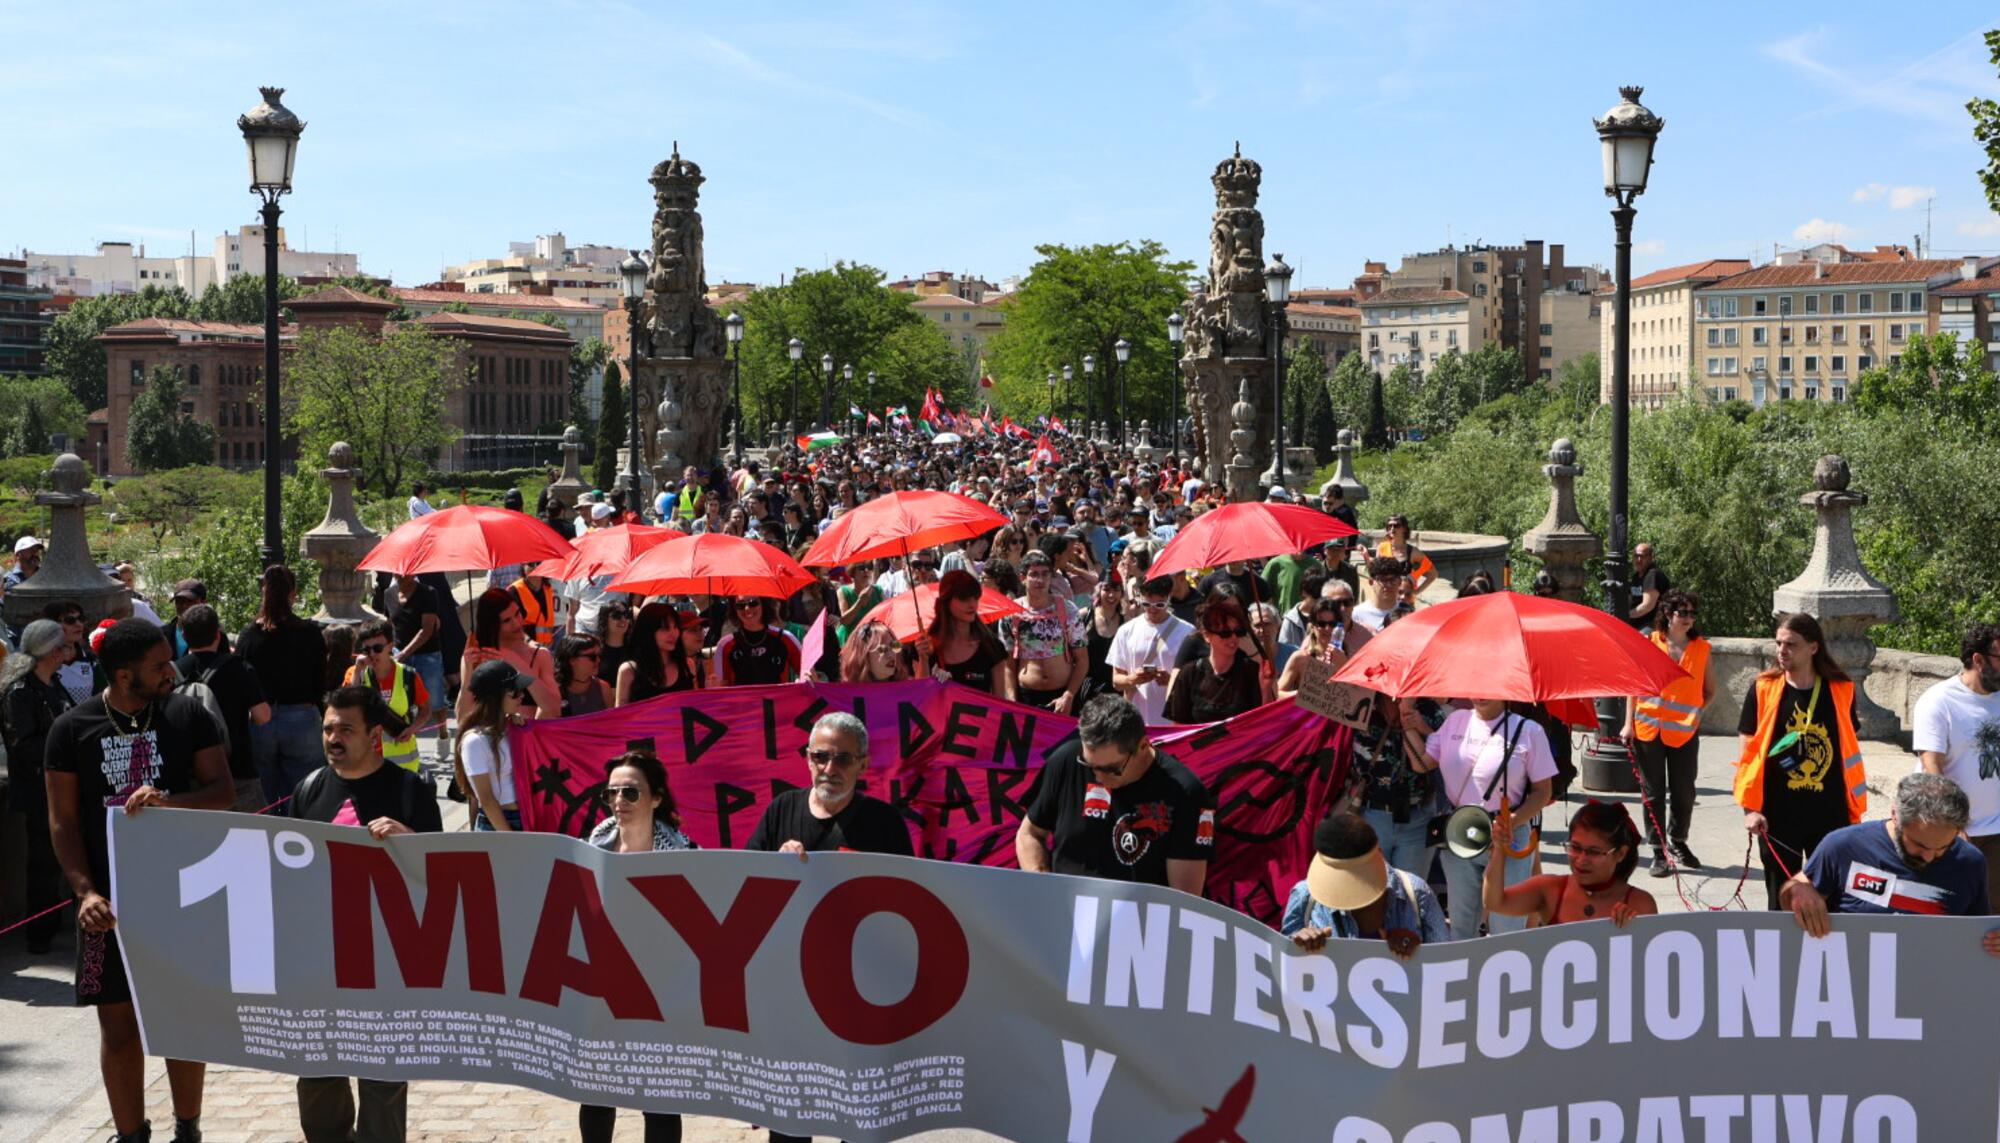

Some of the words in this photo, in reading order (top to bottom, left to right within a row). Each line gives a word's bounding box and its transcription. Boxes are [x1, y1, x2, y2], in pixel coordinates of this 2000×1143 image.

[680, 697, 1066, 770] DISDEN
[1084, 808, 1108, 818] CGT
[1196, 836, 1213, 845] CGT
[1858, 878, 1882, 891] CNT
[326, 841, 969, 1045] MAYO
[1066, 895, 1922, 1069] INTERSECCIONAL
[237, 1006, 292, 1017] AFEMTRAS
[303, 1009, 326, 1017] CGT
[336, 1010, 383, 1019] MCLMEX
[394, 1011, 417, 1019] CNT
[421, 1010, 482, 1022] COMARCAL
[485, 1014, 506, 1024] SUR
[516, 1019, 535, 1029] CNT
[538, 1023, 572, 1041] MADRID
[578, 1038, 615, 1049] COBAS
[626, 1042, 672, 1052] ESPACIO
[677, 1044, 717, 1057] COMÚN
[722, 1050, 742, 1060] 15M
[751, 1056, 764, 1066] LA
[767, 1059, 846, 1078] LABORATORIA
[858, 1068, 884, 1078] LIZA
[893, 1055, 965, 1072] MOVIMIENTO
[239, 1016, 280, 1026] MARIKA
[283, 1020, 326, 1029] MADRID
[338, 1021, 423, 1031] OBSERVATORIO
[428, 1022, 442, 1030] DE
[446, 1023, 477, 1032] DDHH
[481, 1025, 495, 1034] EN
[500, 1027, 531, 1040] SALUD
[535, 1034, 569, 1052] MENTAL
[578, 1050, 628, 1062] ORGULLO
[632, 1054, 662, 1063] LOCO
[667, 1056, 712, 1067] PRENDE
[722, 1061, 792, 1082] PLATAFORMA
[797, 1074, 848, 1090] SINDICAL
[852, 1082, 869, 1091] DE
[873, 1080, 887, 1089] LA
[891, 1073, 911, 1086] EMT
[921, 1068, 944, 1078] RED
[948, 1068, 964, 1076] DE
[242, 1025, 302, 1040] SINDICATOS
[307, 1032, 321, 1040] DE
[326, 1032, 370, 1042] BARRIO:
[374, 1034, 414, 1042] GRUPO
[419, 1034, 456, 1042] ADELA
[460, 1035, 474, 1043] DE
[478, 1036, 492, 1045] LA
[496, 1039, 548, 1056] ASAMBLEA
[551, 1051, 592, 1070] POPULAR
[597, 1062, 610, 1072] DE
[615, 1064, 703, 1078] CARABANCHEL,
[707, 1071, 728, 1081] RAL
[742, 1077, 799, 1094] SINDICATO
[804, 1086, 828, 1096] SAN
[831, 1082, 928, 1104] BLAS-CANILLEJAS
[939, 1080, 963, 1088] RED
[244, 1035, 324, 1050] INTERLAVAPIES
[337, 1042, 395, 1054] SINDICATO
[400, 1045, 415, 1053] DE
[420, 1045, 485, 1055] INQUILINAS
[497, 1050, 549, 1067] SINDICATO
[553, 1063, 563, 1072] DE
[567, 1066, 623, 1084] MANTEROS
[628, 1077, 643, 1085] DE
[648, 1078, 692, 1087] MADRID
[704, 1081, 760, 1099] SINDICATO
[764, 1094, 800, 1107] OTRAS
[815, 1099, 879, 1117] SINTRAHOC
[891, 1091, 962, 1111] SOLIDARIDAD
[245, 1046, 286, 1059] OBRERA
[305, 1053, 328, 1061] SOS
[338, 1052, 386, 1065] RACISMO
[395, 1055, 440, 1065] MADRID
[462, 1058, 491, 1067] STEM
[512, 1062, 555, 1080] TABADOL
[571, 1079, 635, 1095] TERRITORIO
[644, 1088, 711, 1100] DOMÉSTICO
[731, 1096, 766, 1111] TRANS
[773, 1108, 787, 1117] EN
[798, 1107, 837, 1122] LUCHA
[856, 1112, 908, 1129] VALIENTE
[916, 1104, 962, 1116] BANGLA
[1062, 1039, 1116, 1143] Y
